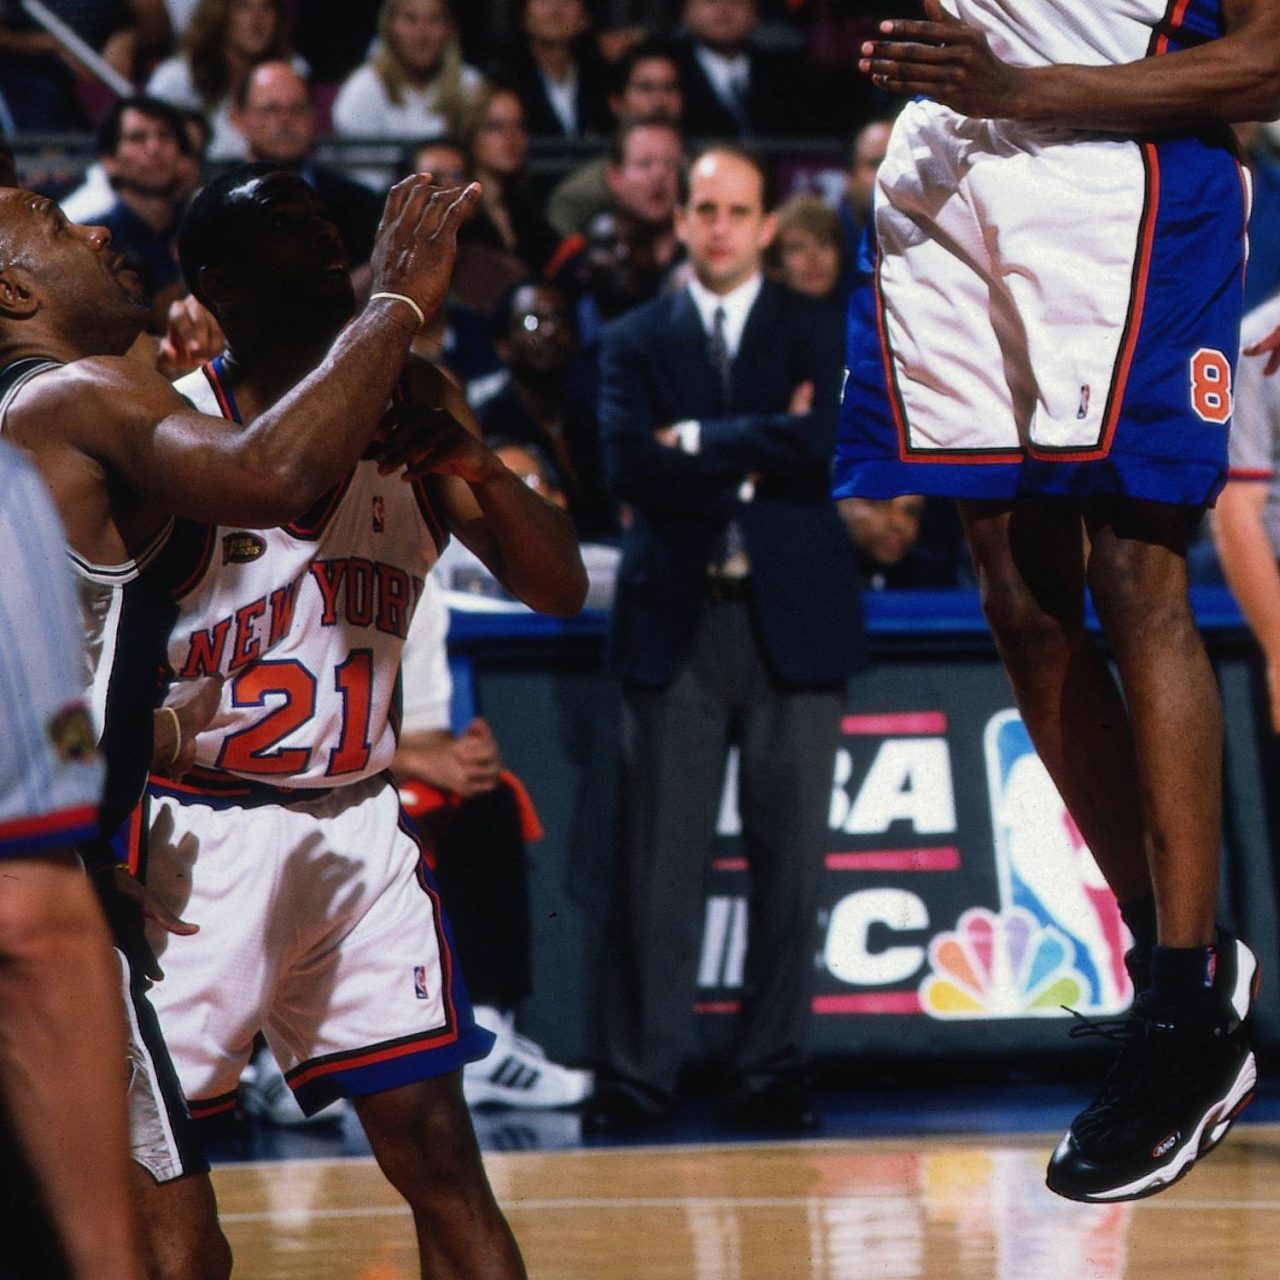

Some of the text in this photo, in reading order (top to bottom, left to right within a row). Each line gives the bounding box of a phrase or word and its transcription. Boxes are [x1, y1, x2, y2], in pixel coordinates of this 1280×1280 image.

[1190, 348, 1234, 425] 8
[310, 557, 425, 641] YOR
[214, 647, 374, 777] 21
